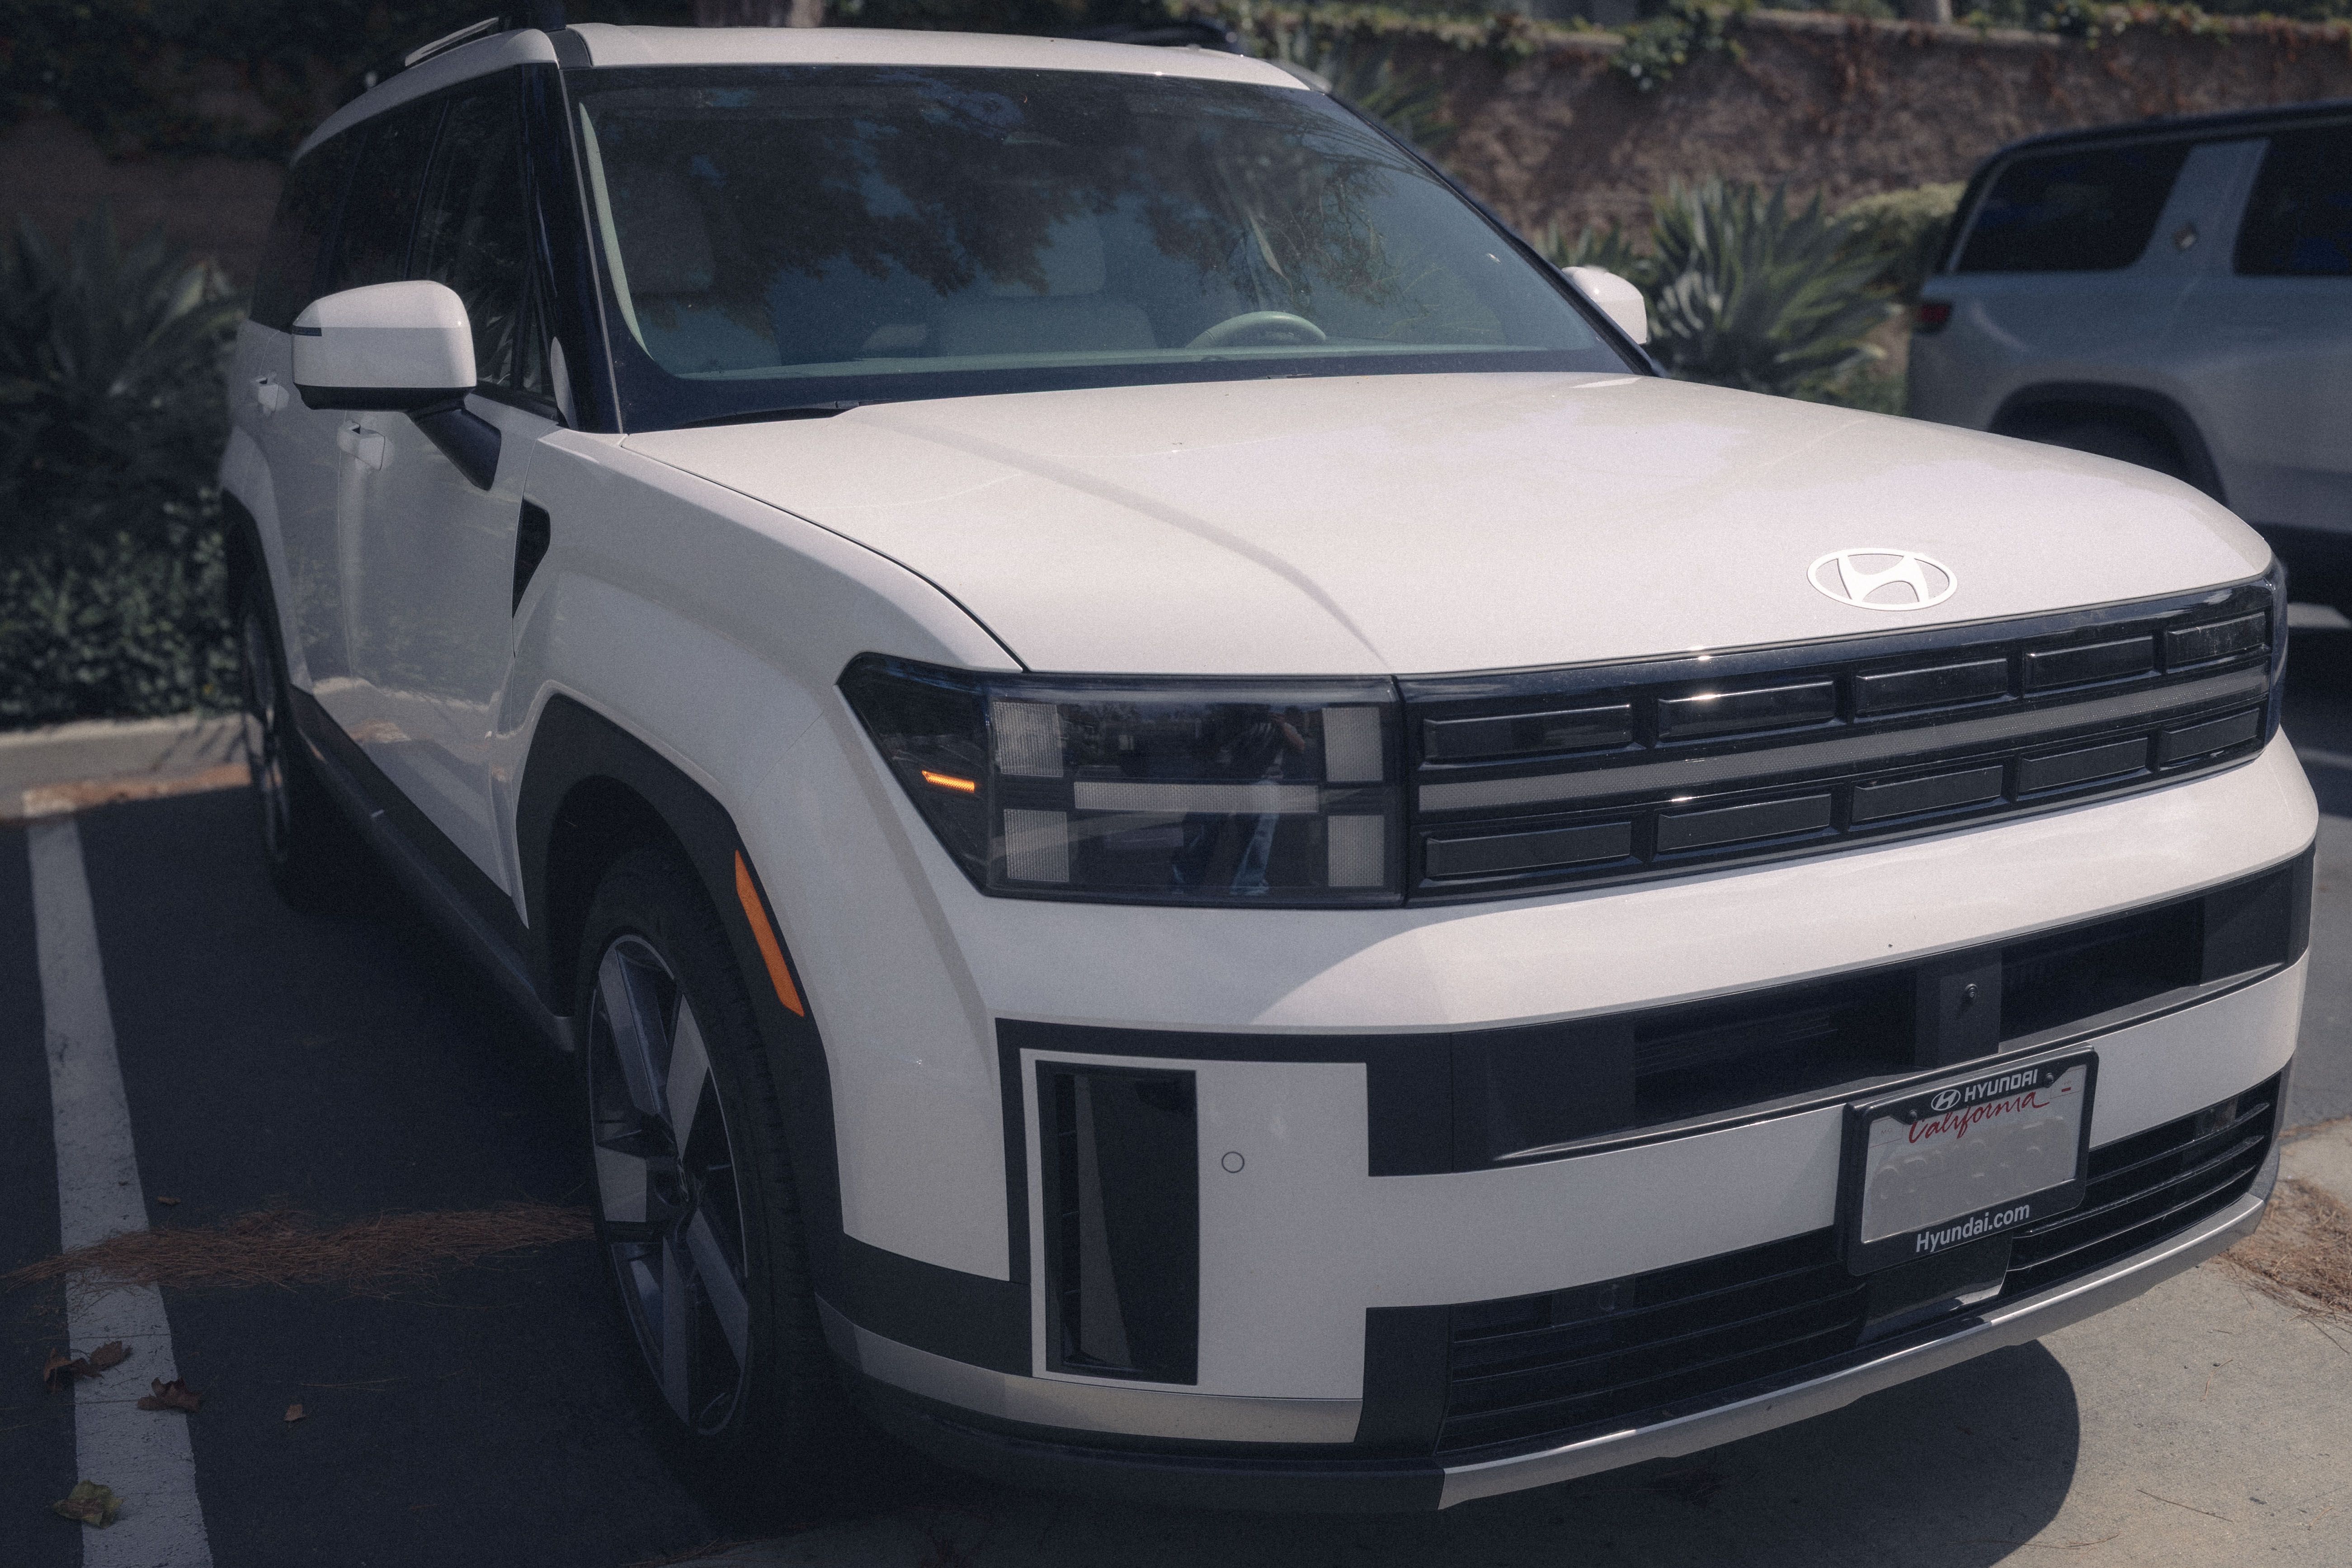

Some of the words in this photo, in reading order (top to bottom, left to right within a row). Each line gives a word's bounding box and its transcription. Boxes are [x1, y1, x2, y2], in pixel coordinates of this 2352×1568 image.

[1964, 1069, 2038, 1102] HYUNDAI
[1909, 1091, 2050, 1144] California
[1916, 1204, 2030, 1253] Hyundai.com
